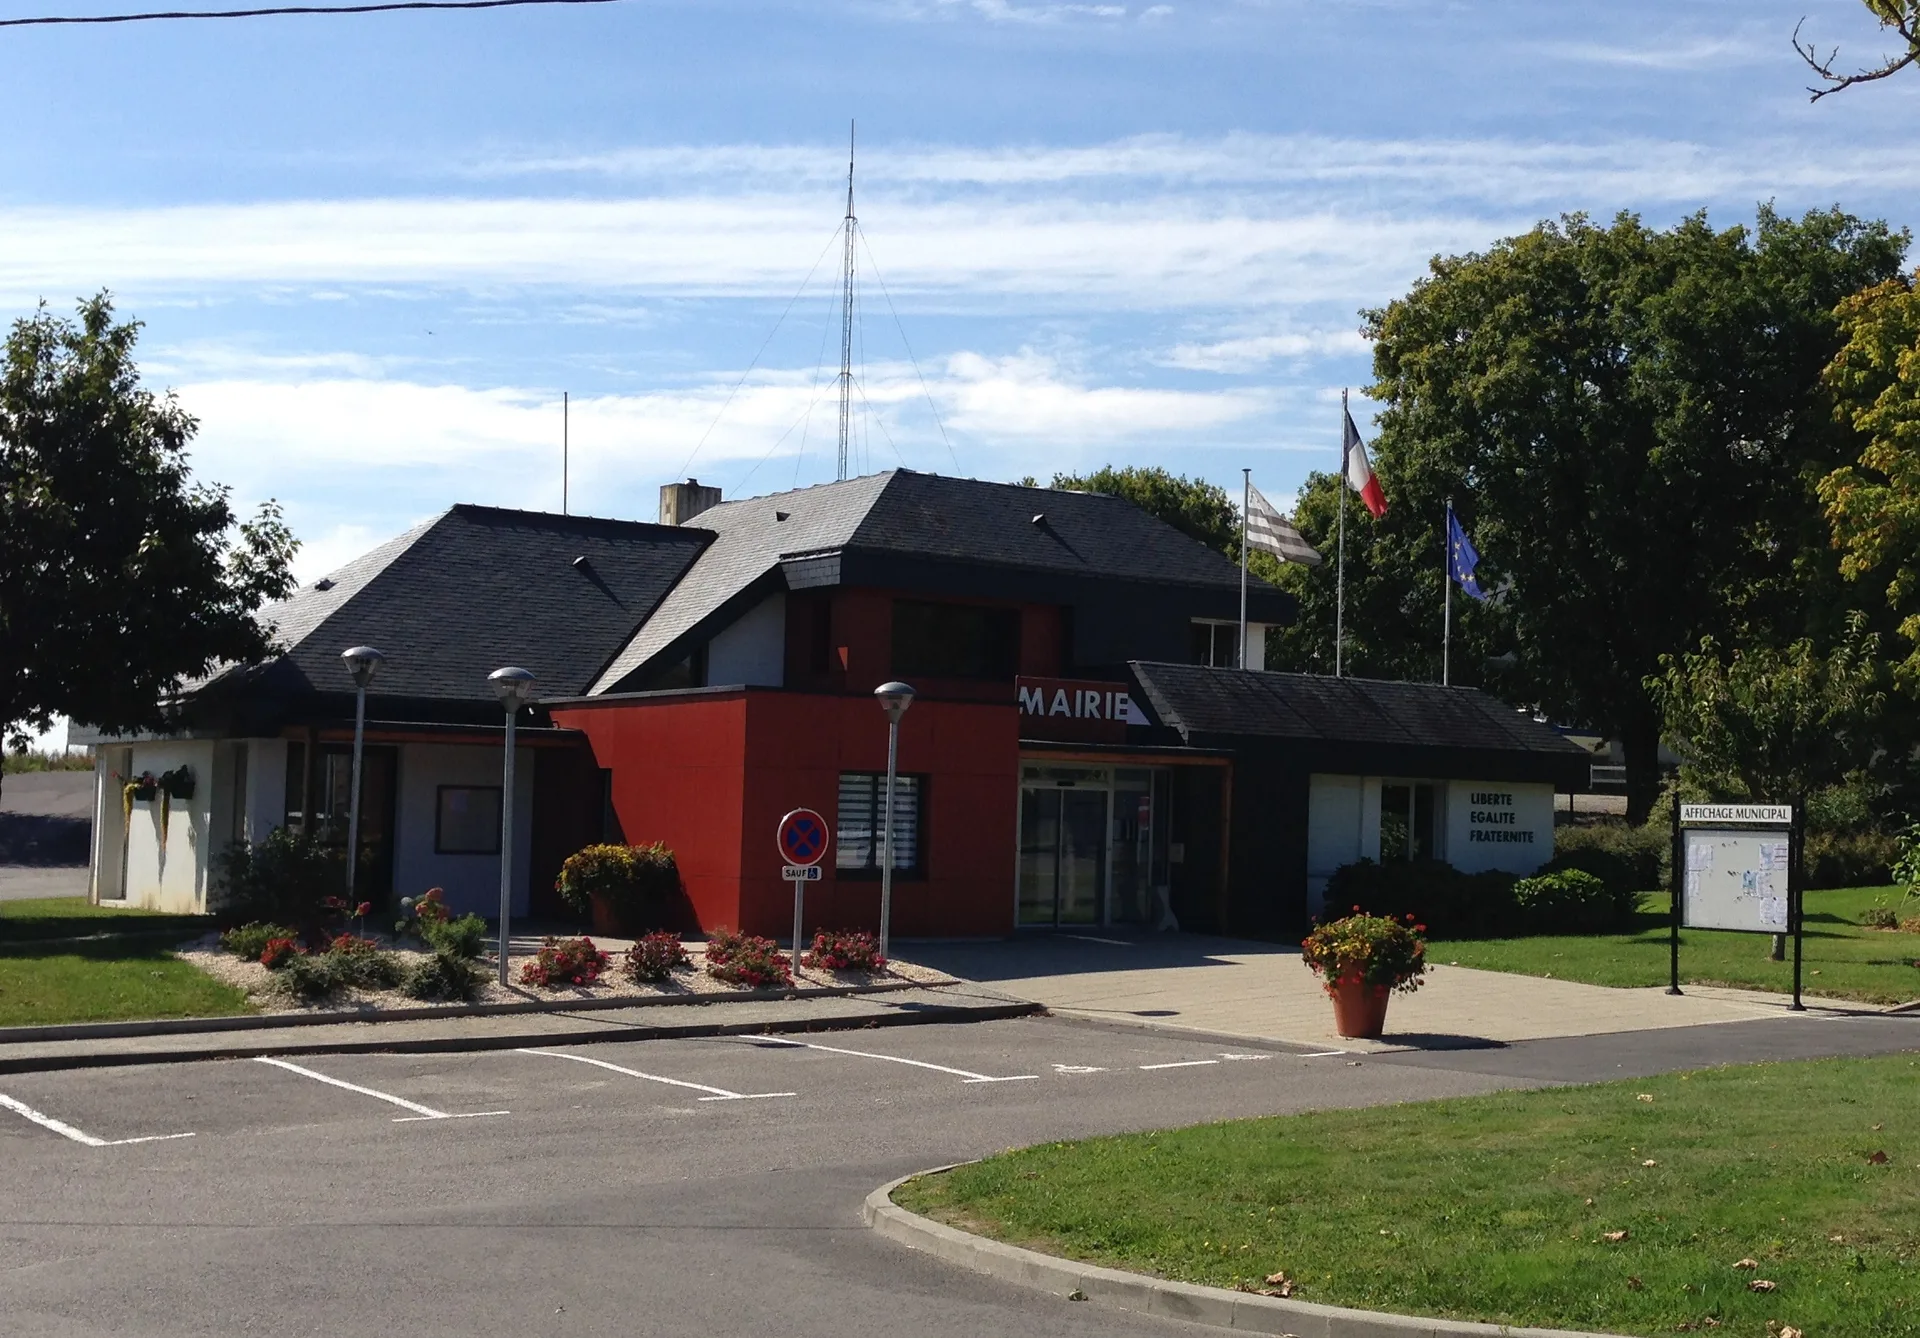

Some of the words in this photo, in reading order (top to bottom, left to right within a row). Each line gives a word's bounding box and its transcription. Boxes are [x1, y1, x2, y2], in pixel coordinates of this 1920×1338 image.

[1019, 686, 1129, 720] MAIRIE
[1471, 792, 1512, 806] LIBERTE
[1470, 811, 1515, 824] EGALITE
[1684, 807, 1733, 819] AFFICHAGE
[1735, 808, 1788, 820] MUNICIPAL
[1470, 830, 1534, 843] FRATERNITE
[785, 869, 807, 878] SAUF
